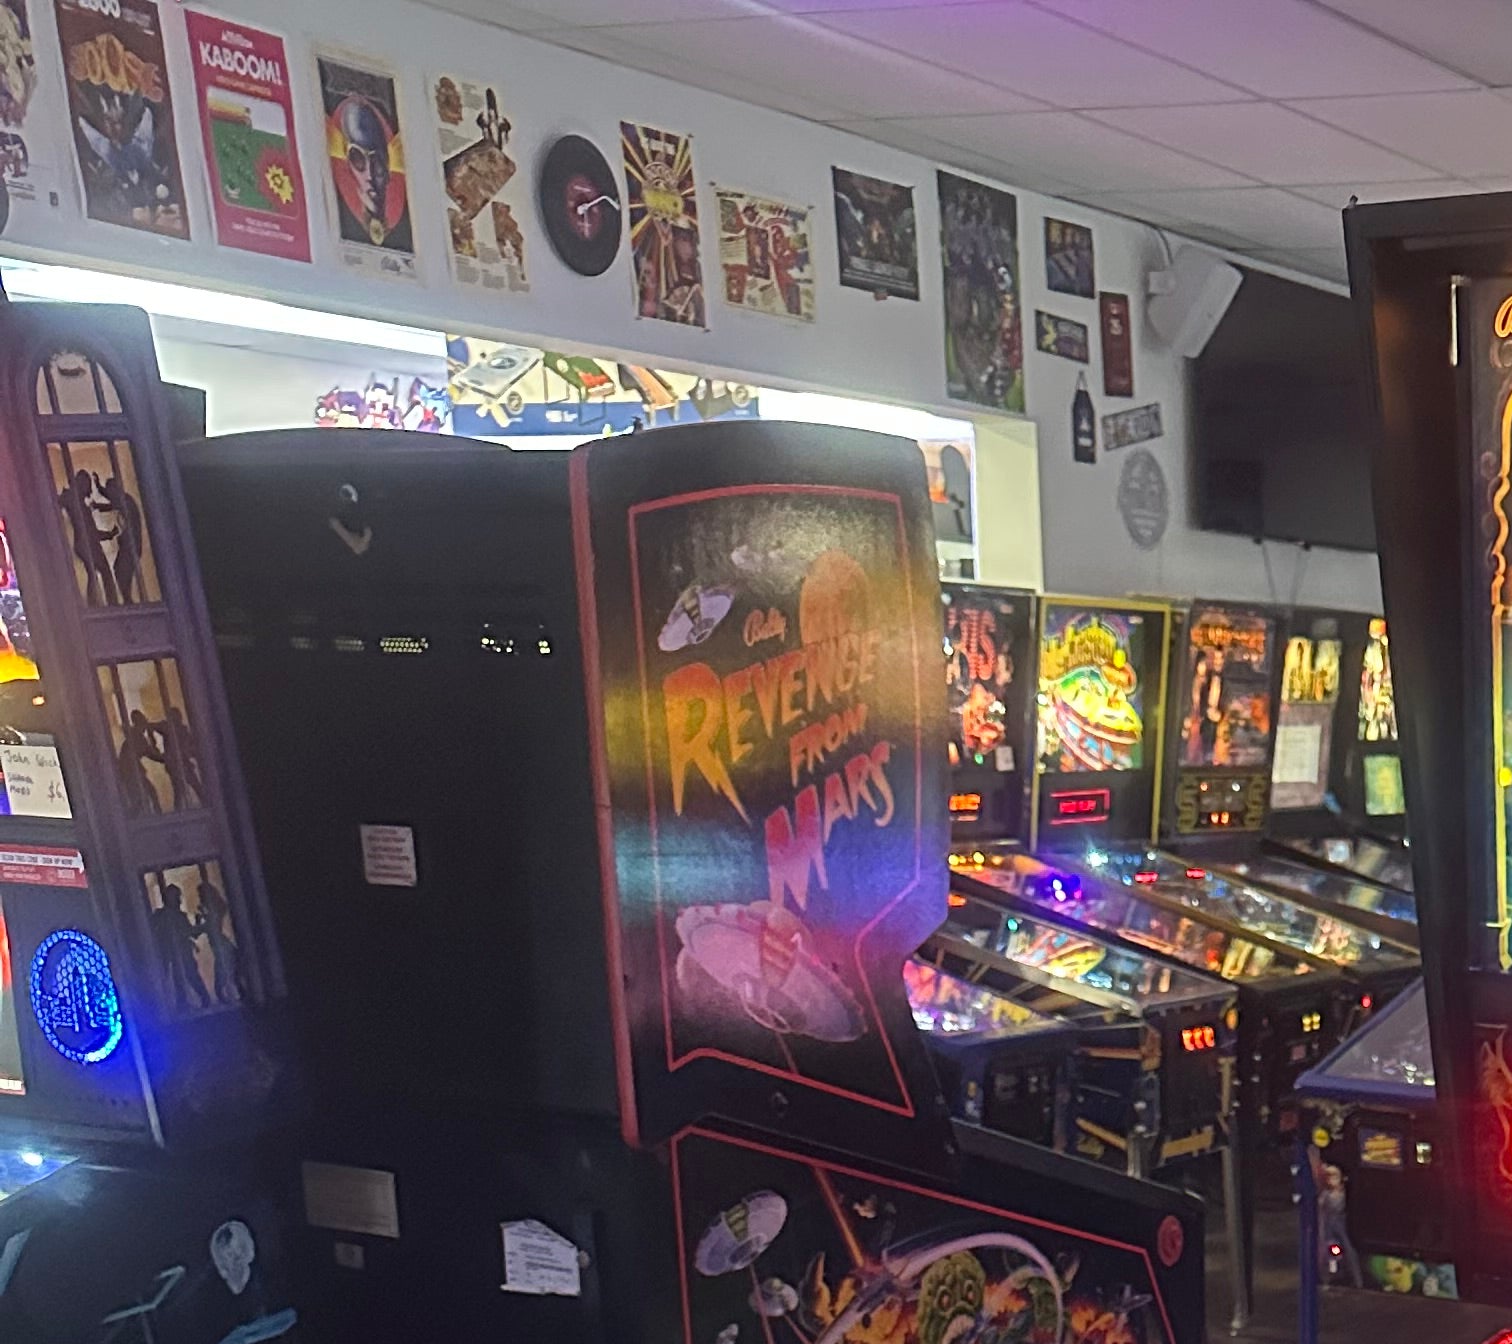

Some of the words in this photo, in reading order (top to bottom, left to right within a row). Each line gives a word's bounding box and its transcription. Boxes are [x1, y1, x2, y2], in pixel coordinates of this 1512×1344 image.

[199, 40, 283, 86] KABOOM!
[662, 628, 884, 828] REVENGE
[788, 702, 869, 789] FROM
[763, 740, 896, 911] MARS
